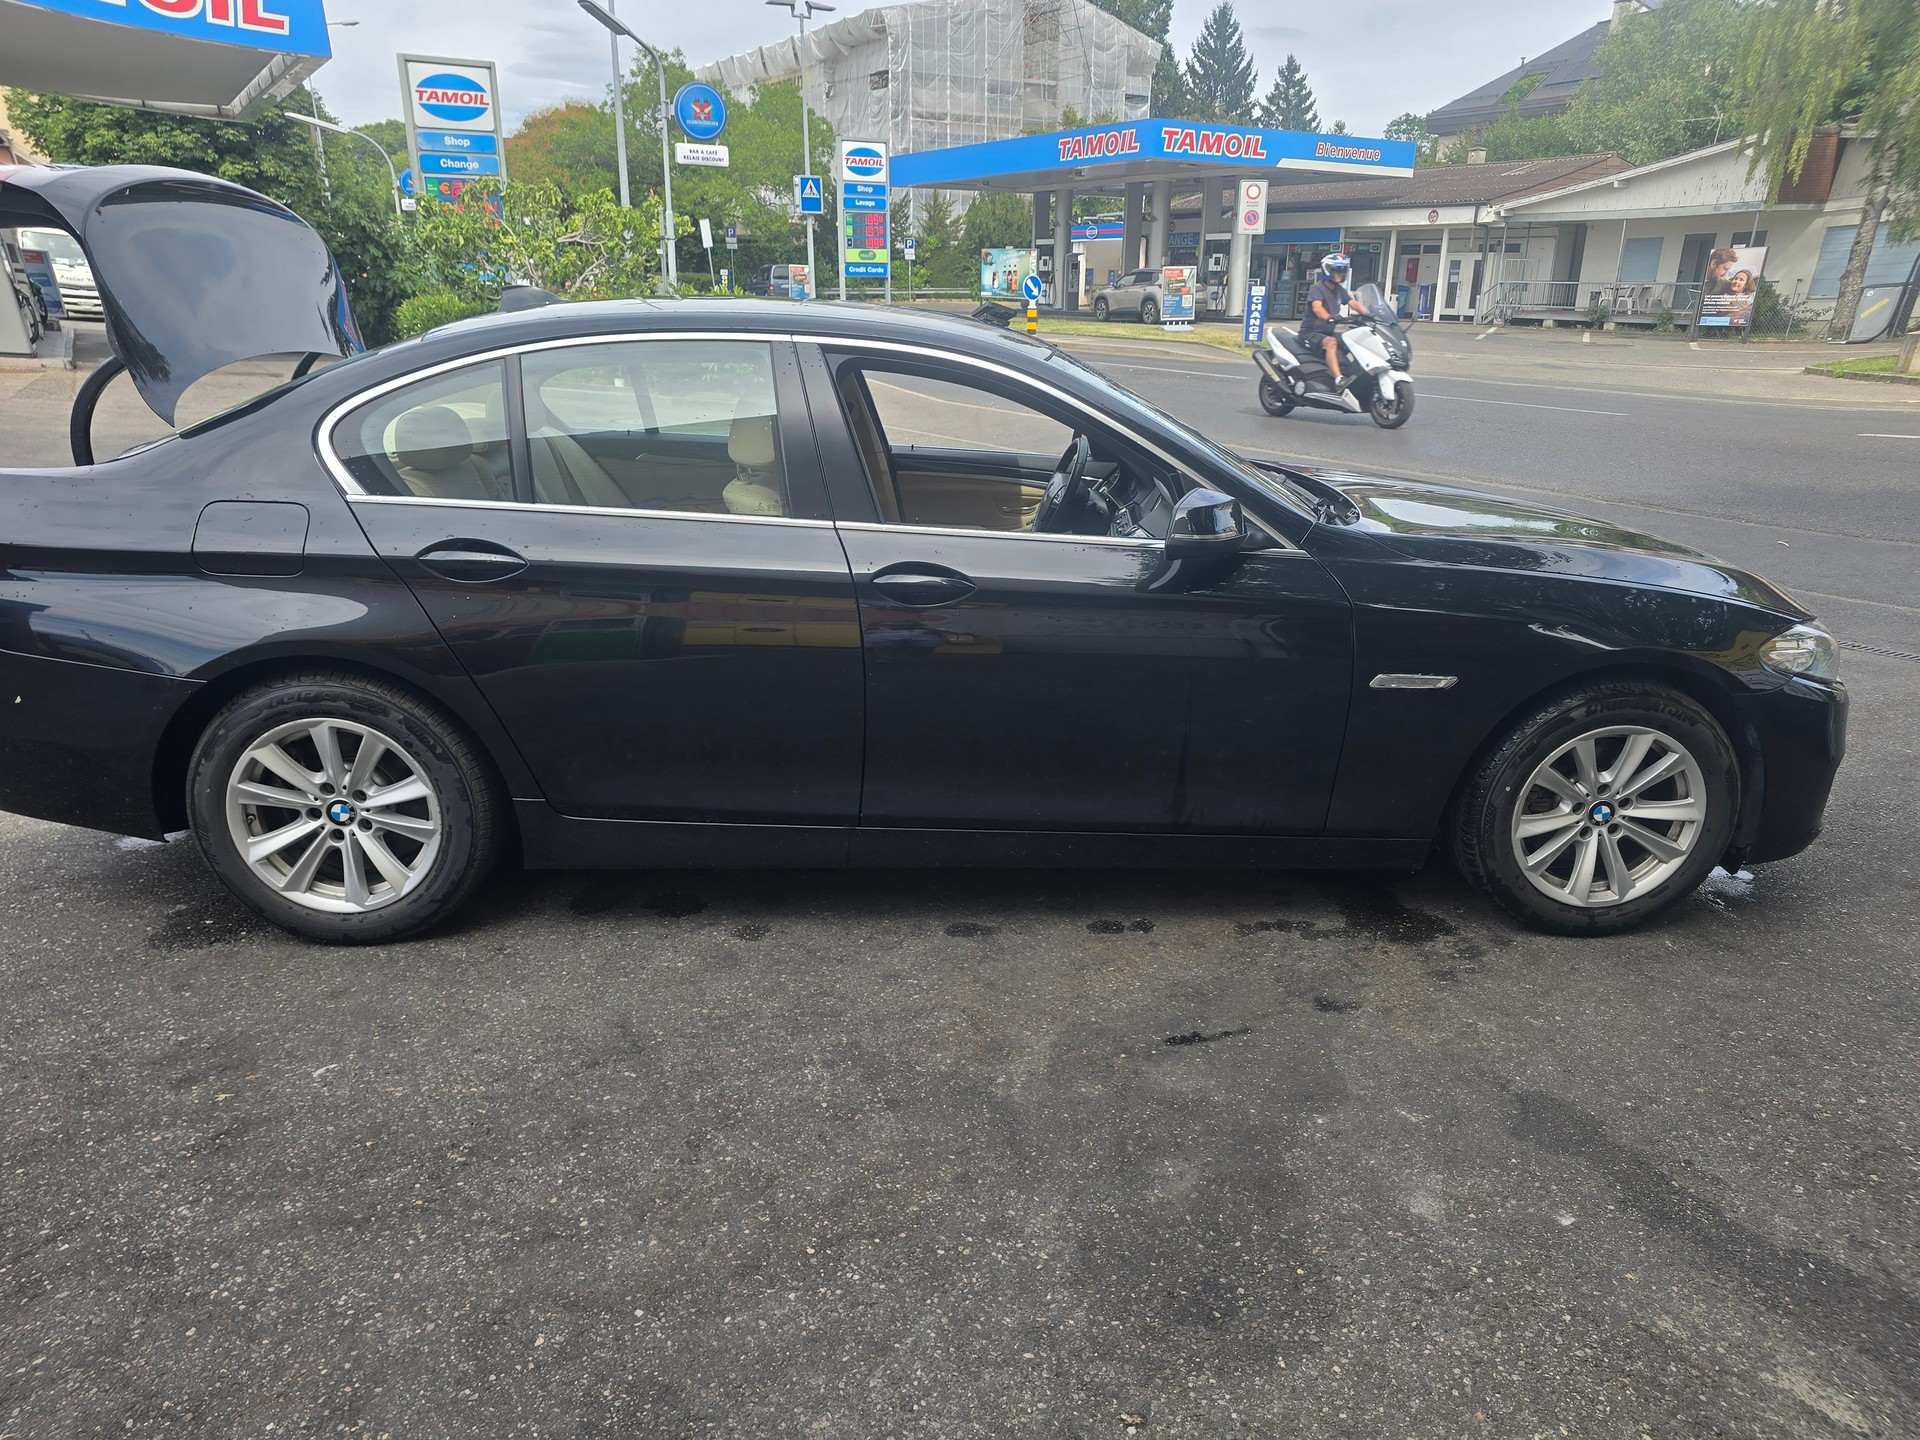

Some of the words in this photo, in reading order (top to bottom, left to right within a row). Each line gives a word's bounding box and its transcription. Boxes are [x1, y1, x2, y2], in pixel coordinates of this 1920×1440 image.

[415, 89, 489, 106] TAMOIL
[444, 136, 471, 148] Shop
[1058, 128, 1140, 161] TAMOIL
[1161, 127, 1267, 160] TAMOIL
[1315, 141, 1382, 162] Bienvenue
[439, 158, 479, 169] Change
[844, 157, 885, 167] TAMOIL
[856, 185, 874, 194] Shop
[727, 228, 734, 237] P
[906, 239, 913, 249] P
[1168, 232, 1194, 246] ANGE
[848, 265, 867, 273] Credit
[867, 266, 885, 274] Cards
[1248, 296, 1263, 341] CHANGE
